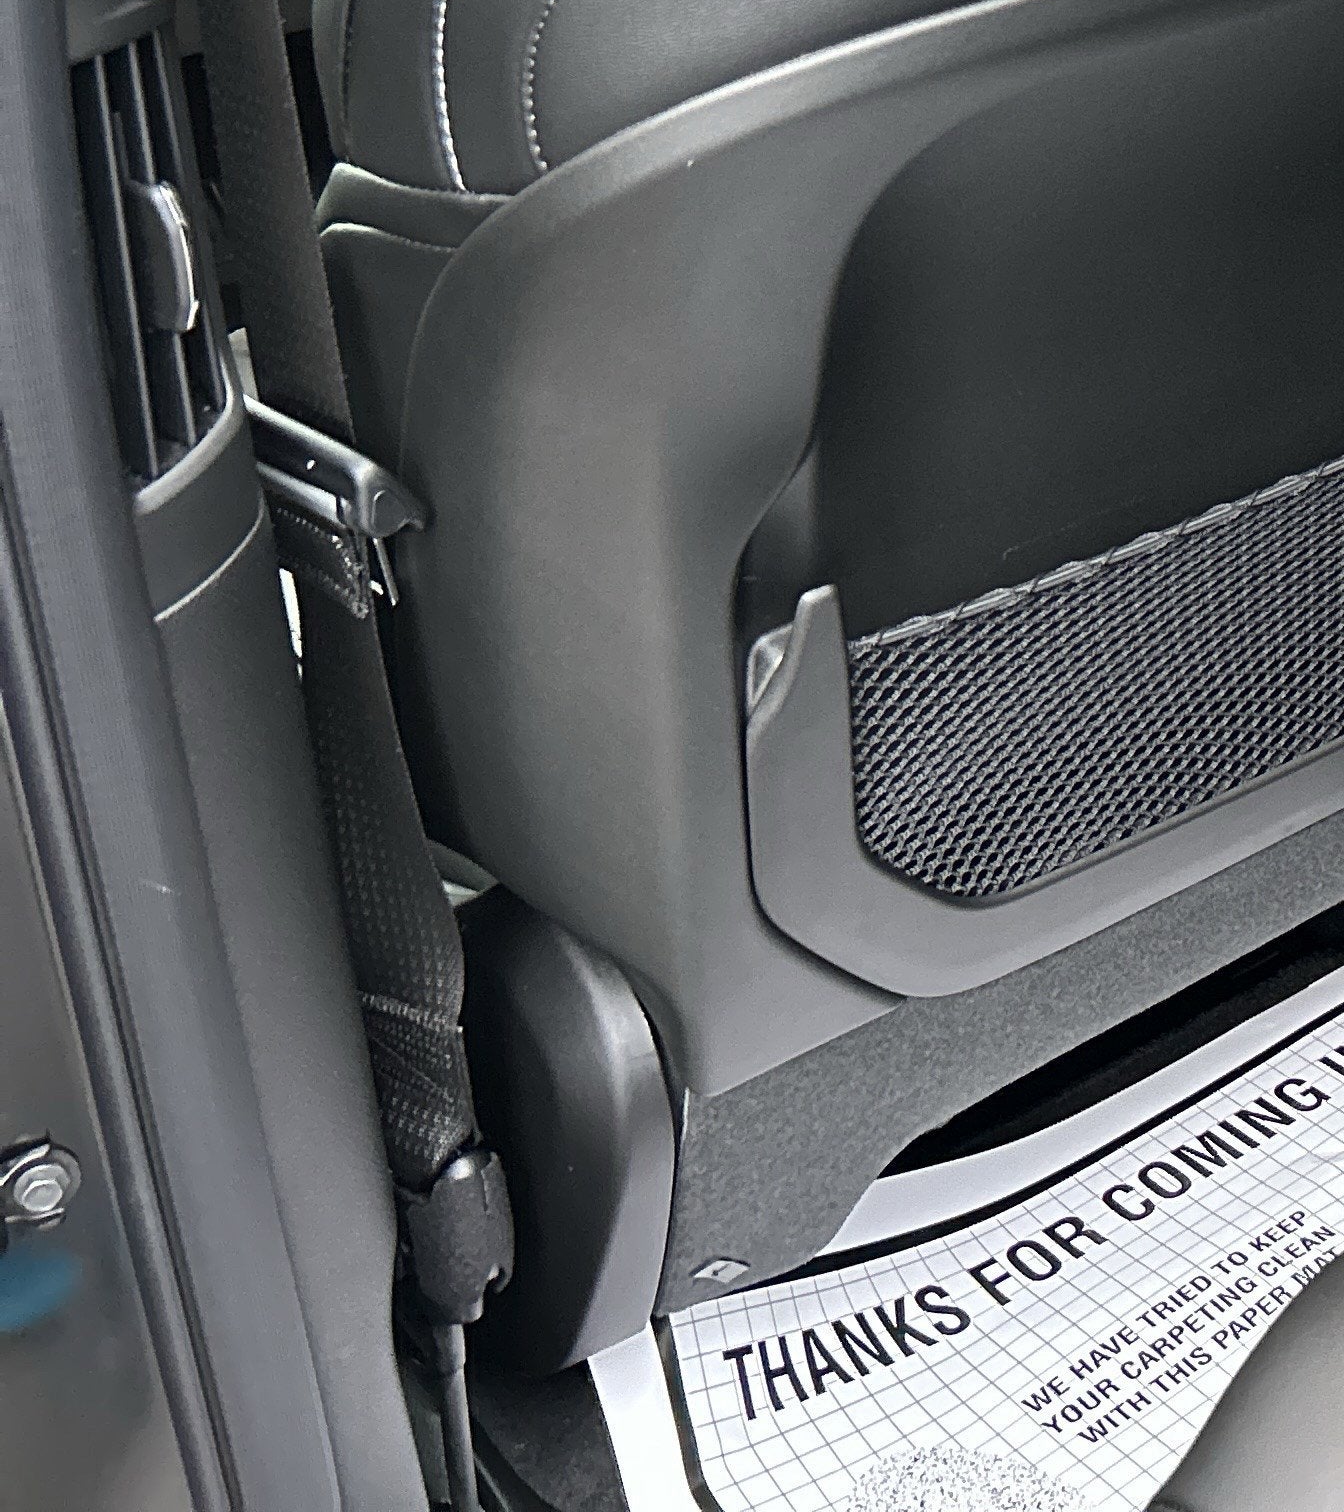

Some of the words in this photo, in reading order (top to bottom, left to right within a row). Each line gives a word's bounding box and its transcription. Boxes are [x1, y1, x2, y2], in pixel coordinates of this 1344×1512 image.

[722, 1284, 972, 1421] THANKS
[967, 1214, 1108, 1306] FOR
[1101, 1076, 1333, 1222] COMING
[1020, 1376, 1071, 1412] WE
[1068, 1325, 1140, 1381] HAVE
[1135, 1274, 1213, 1328] TRIED
[1210, 1250, 1250, 1275] TO
[1248, 1210, 1306, 1252] KEEP
[1040, 1377, 1121, 1434] YOUR
[1120, 1275, 1259, 1380] CARPETING
[1257, 1225, 1336, 1278] CLEAN
[1077, 1390, 1153, 1444] WITH
[1148, 1345, 1213, 1393] THIS
[1210, 1284, 1294, 1350] PAPER
[1290, 1245, 1340, 1289] MAT
